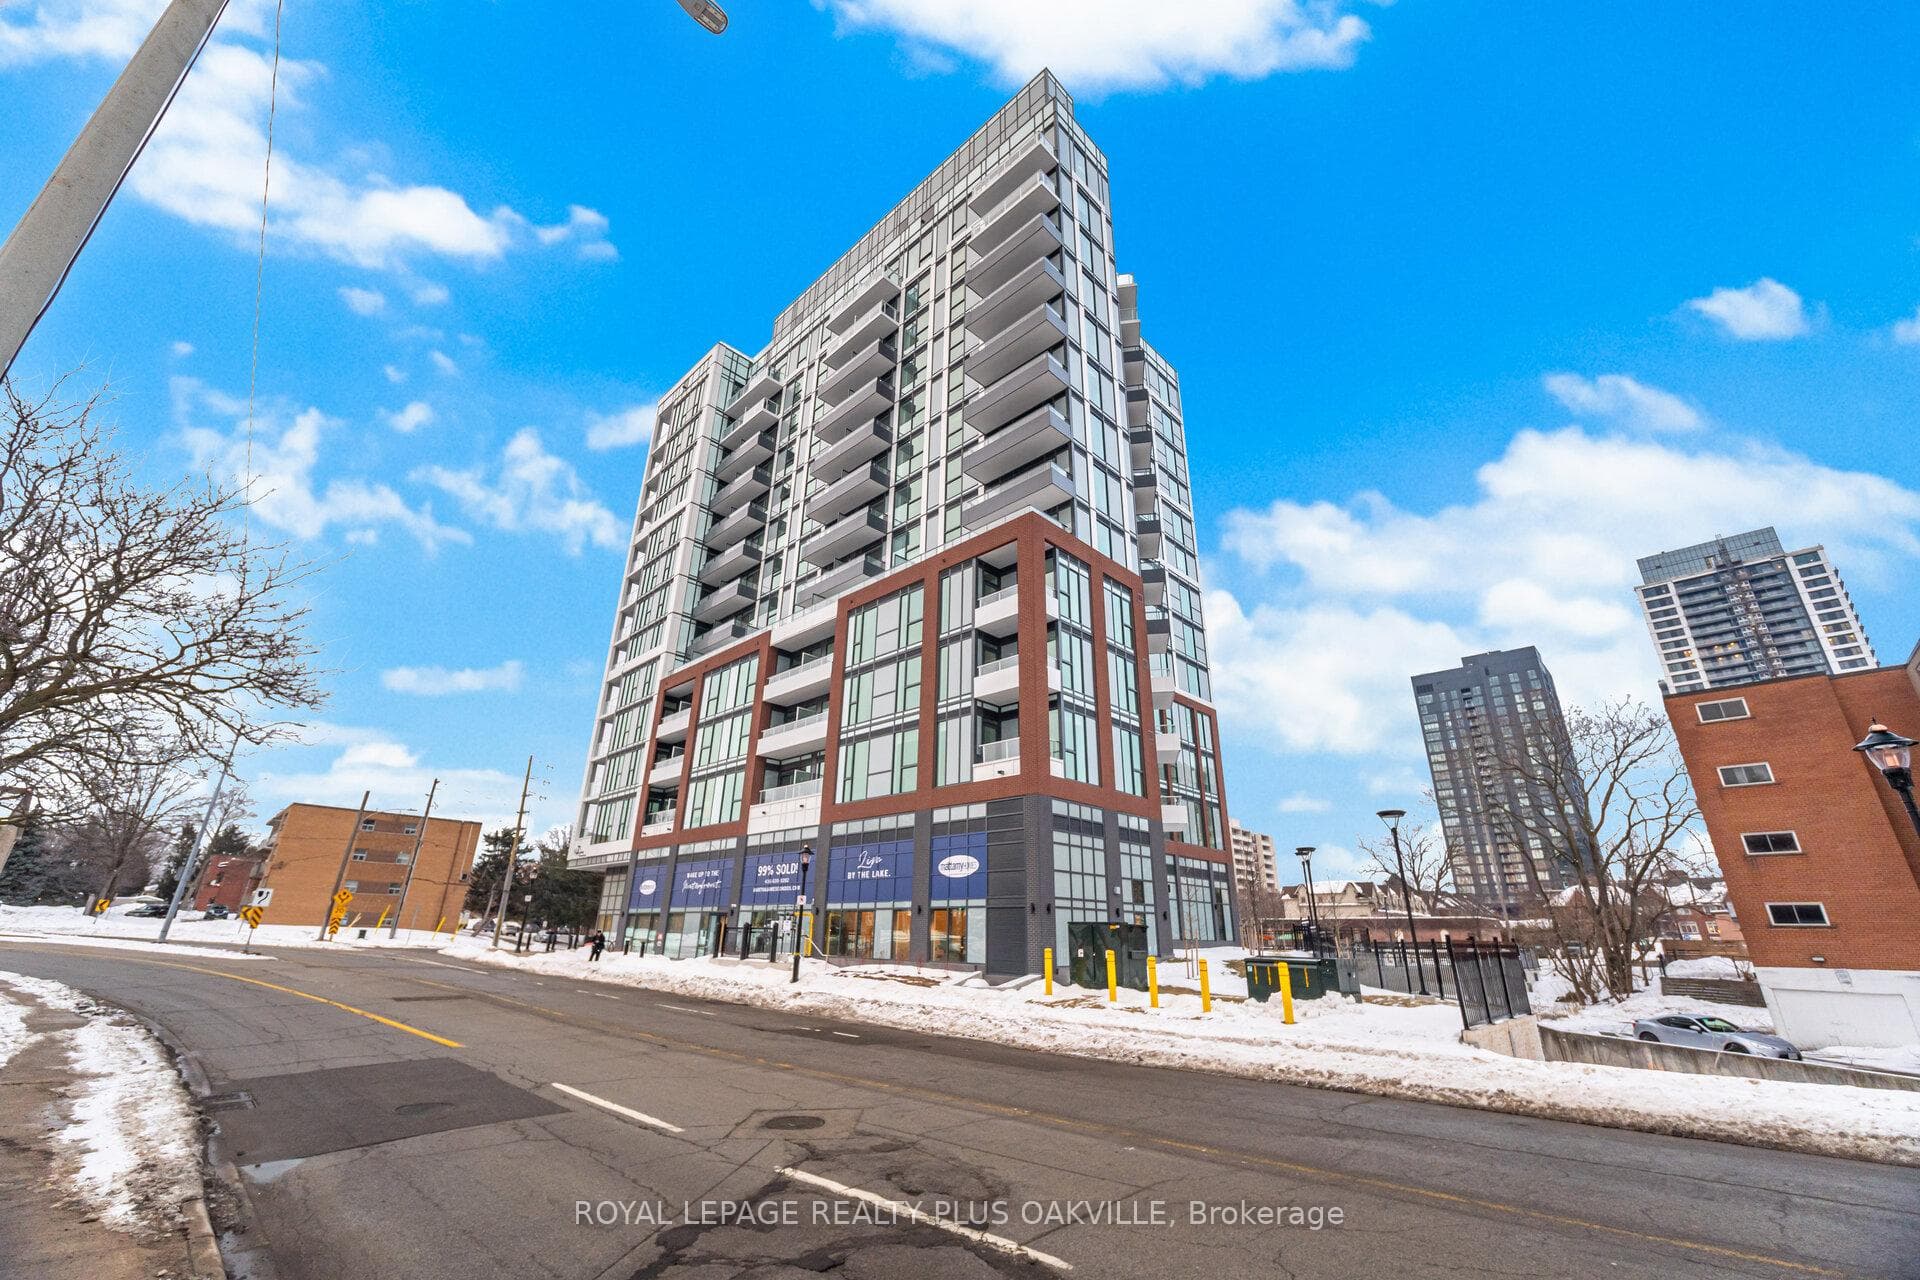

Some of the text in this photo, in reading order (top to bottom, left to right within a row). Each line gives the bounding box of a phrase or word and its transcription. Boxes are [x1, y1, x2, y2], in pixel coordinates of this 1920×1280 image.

[757, 862, 799, 877] 99% SOLD!
[847, 869, 891, 880] BY THE LAKE.
